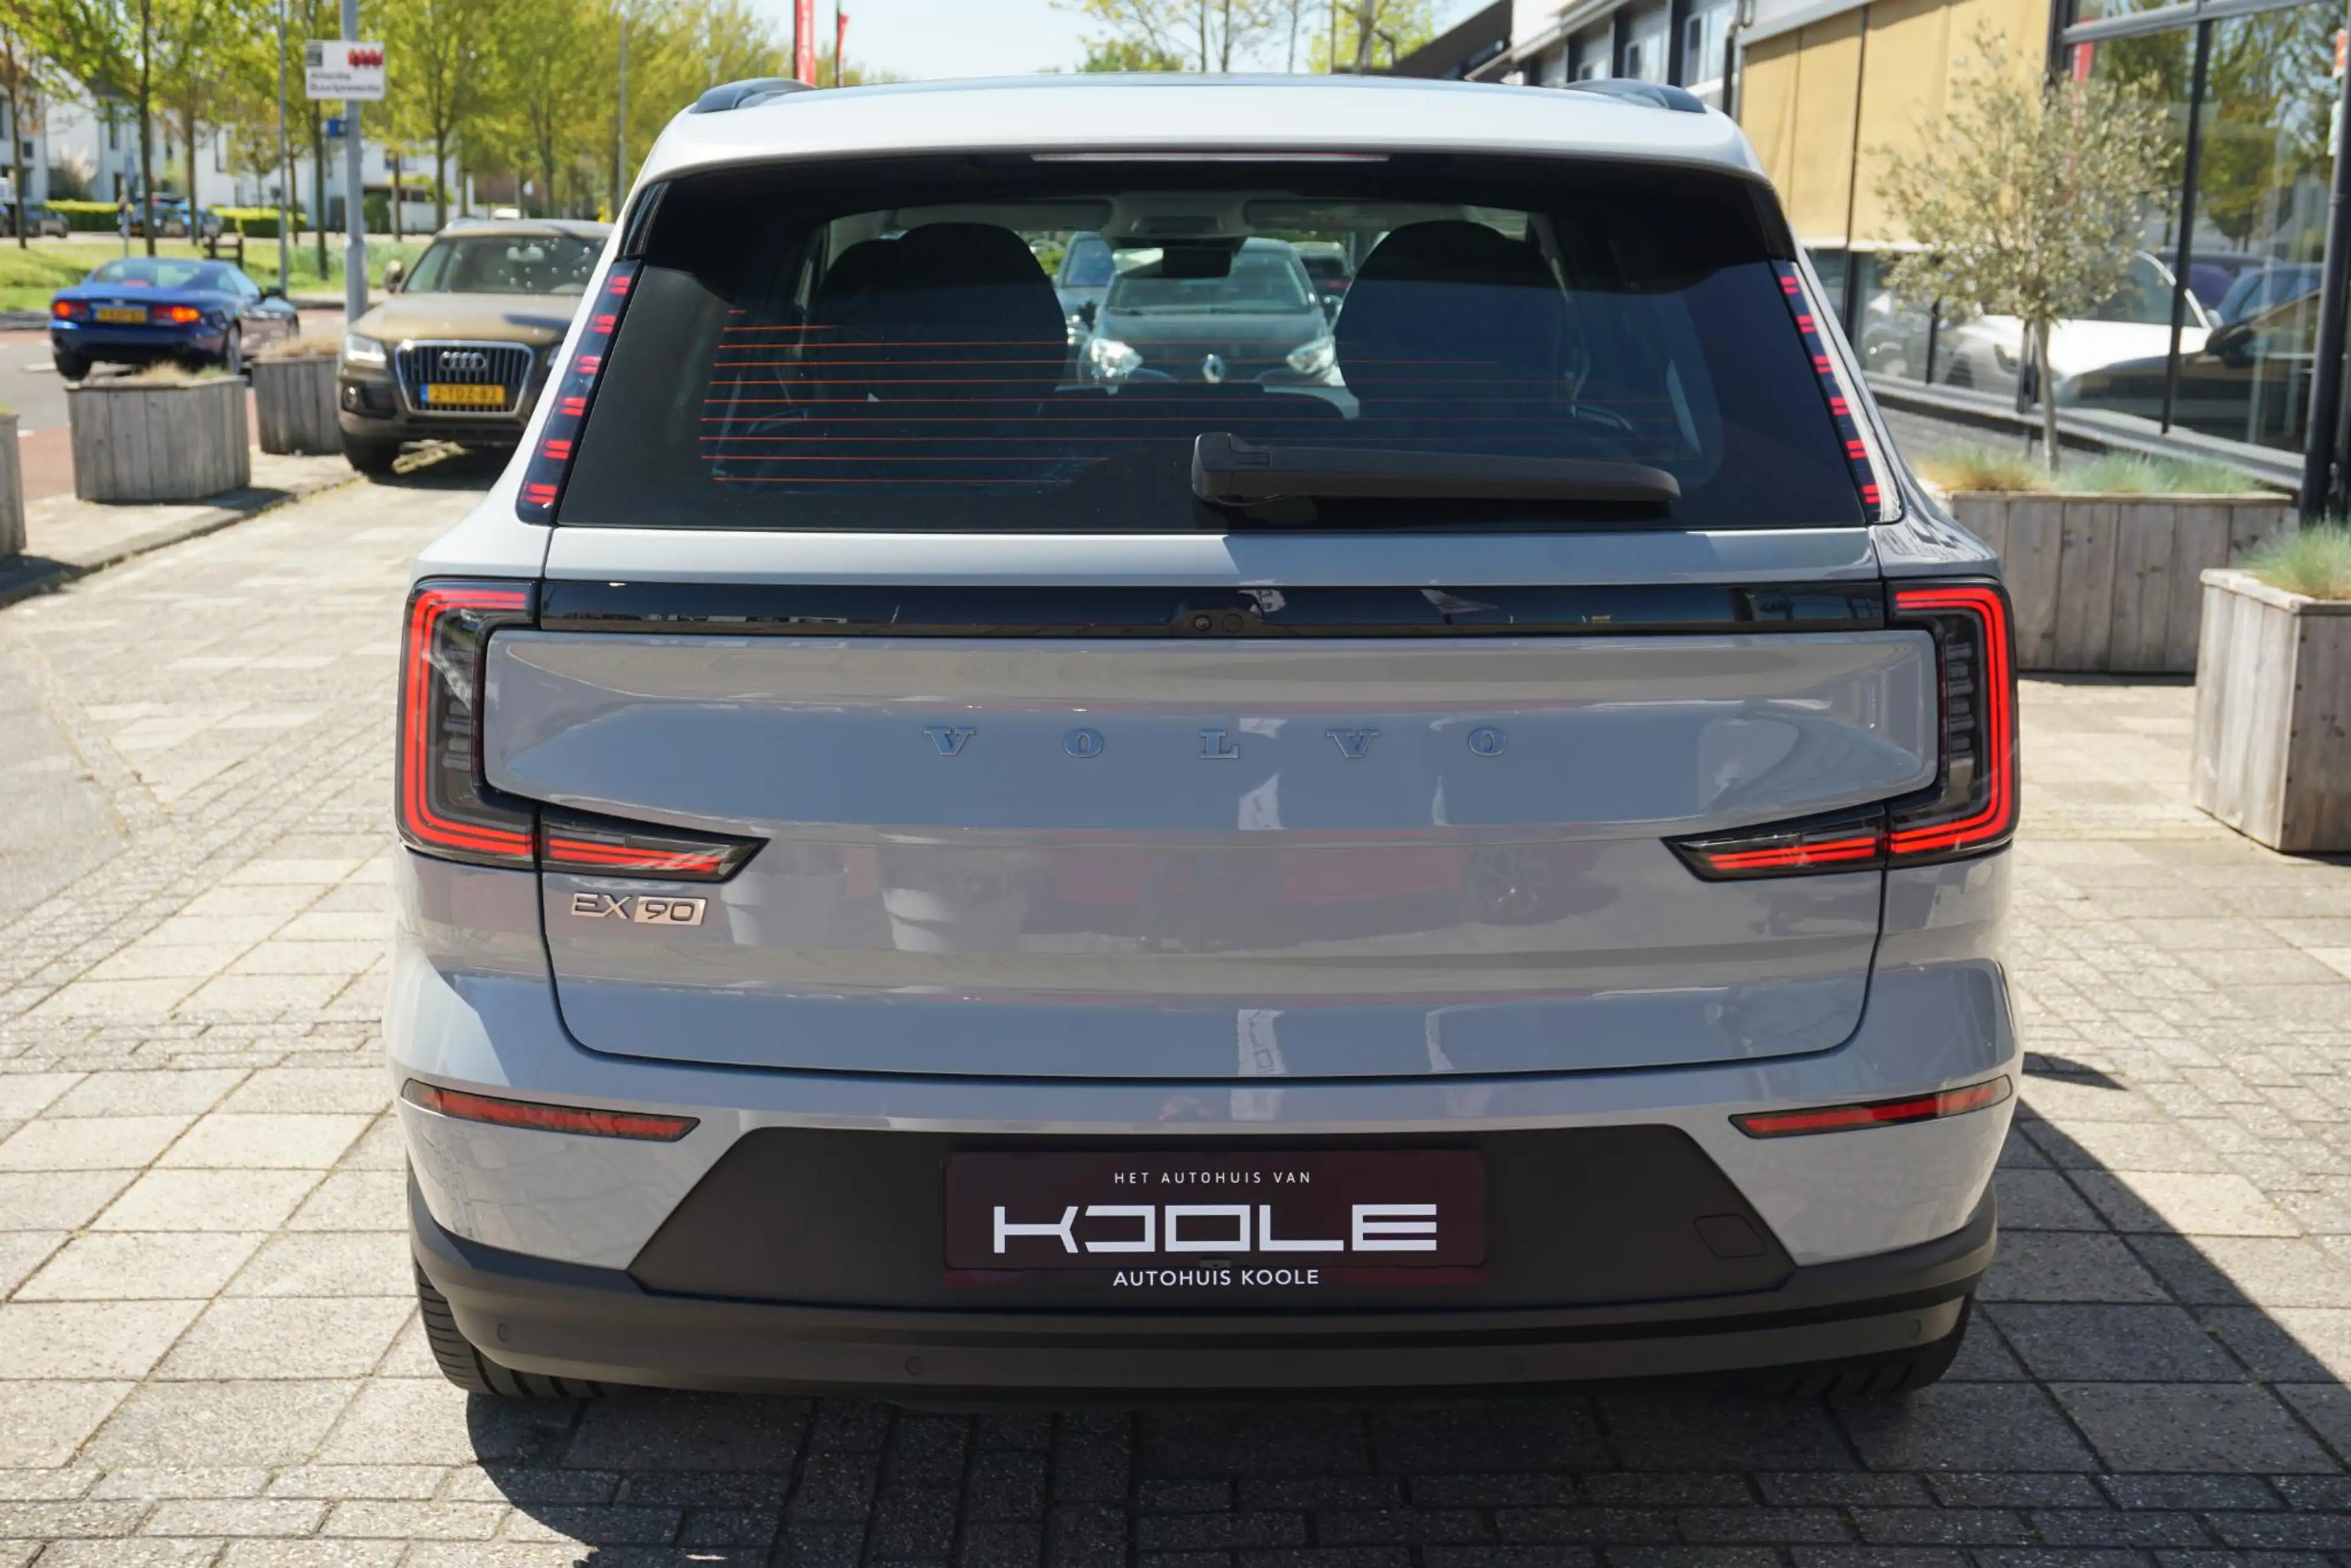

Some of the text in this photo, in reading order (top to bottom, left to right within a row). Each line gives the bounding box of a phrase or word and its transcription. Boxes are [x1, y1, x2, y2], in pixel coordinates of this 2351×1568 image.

[922, 726, 1507, 759] VOLVO
[1114, 1172, 1310, 1184] HET AUTOHUIS VAN
[994, 1204, 1437, 1253] KOOLE
[1113, 1269, 1318, 1286] AUTOHUIS KOOLE
